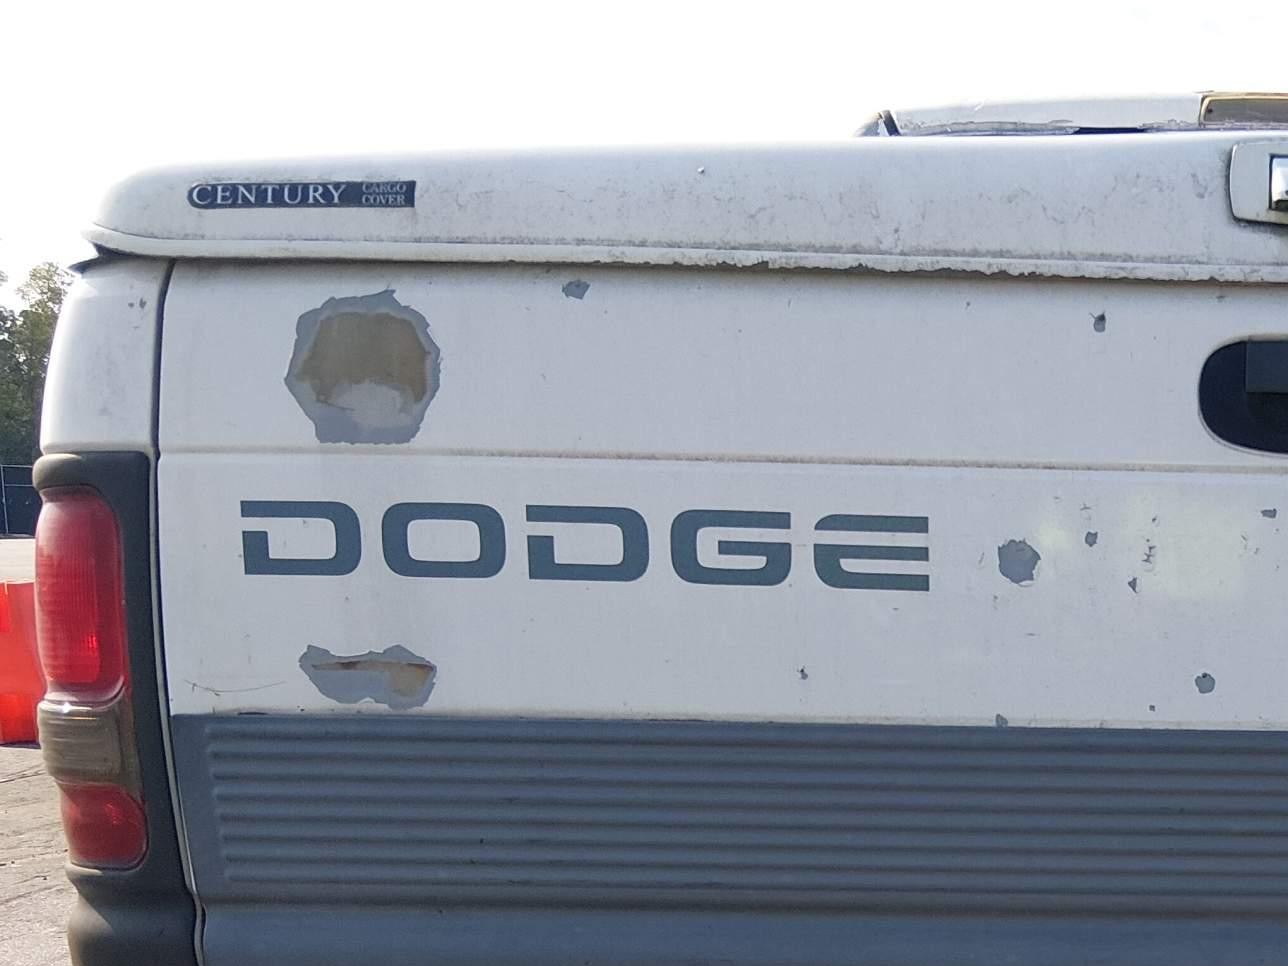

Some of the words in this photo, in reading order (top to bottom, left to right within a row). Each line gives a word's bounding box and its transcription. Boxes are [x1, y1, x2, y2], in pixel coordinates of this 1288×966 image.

[192, 183, 347, 205] CENTURY
[361, 182, 407, 193] CARGO
[361, 194, 407, 205] COVER
[240, 500, 930, 592] DODGE
